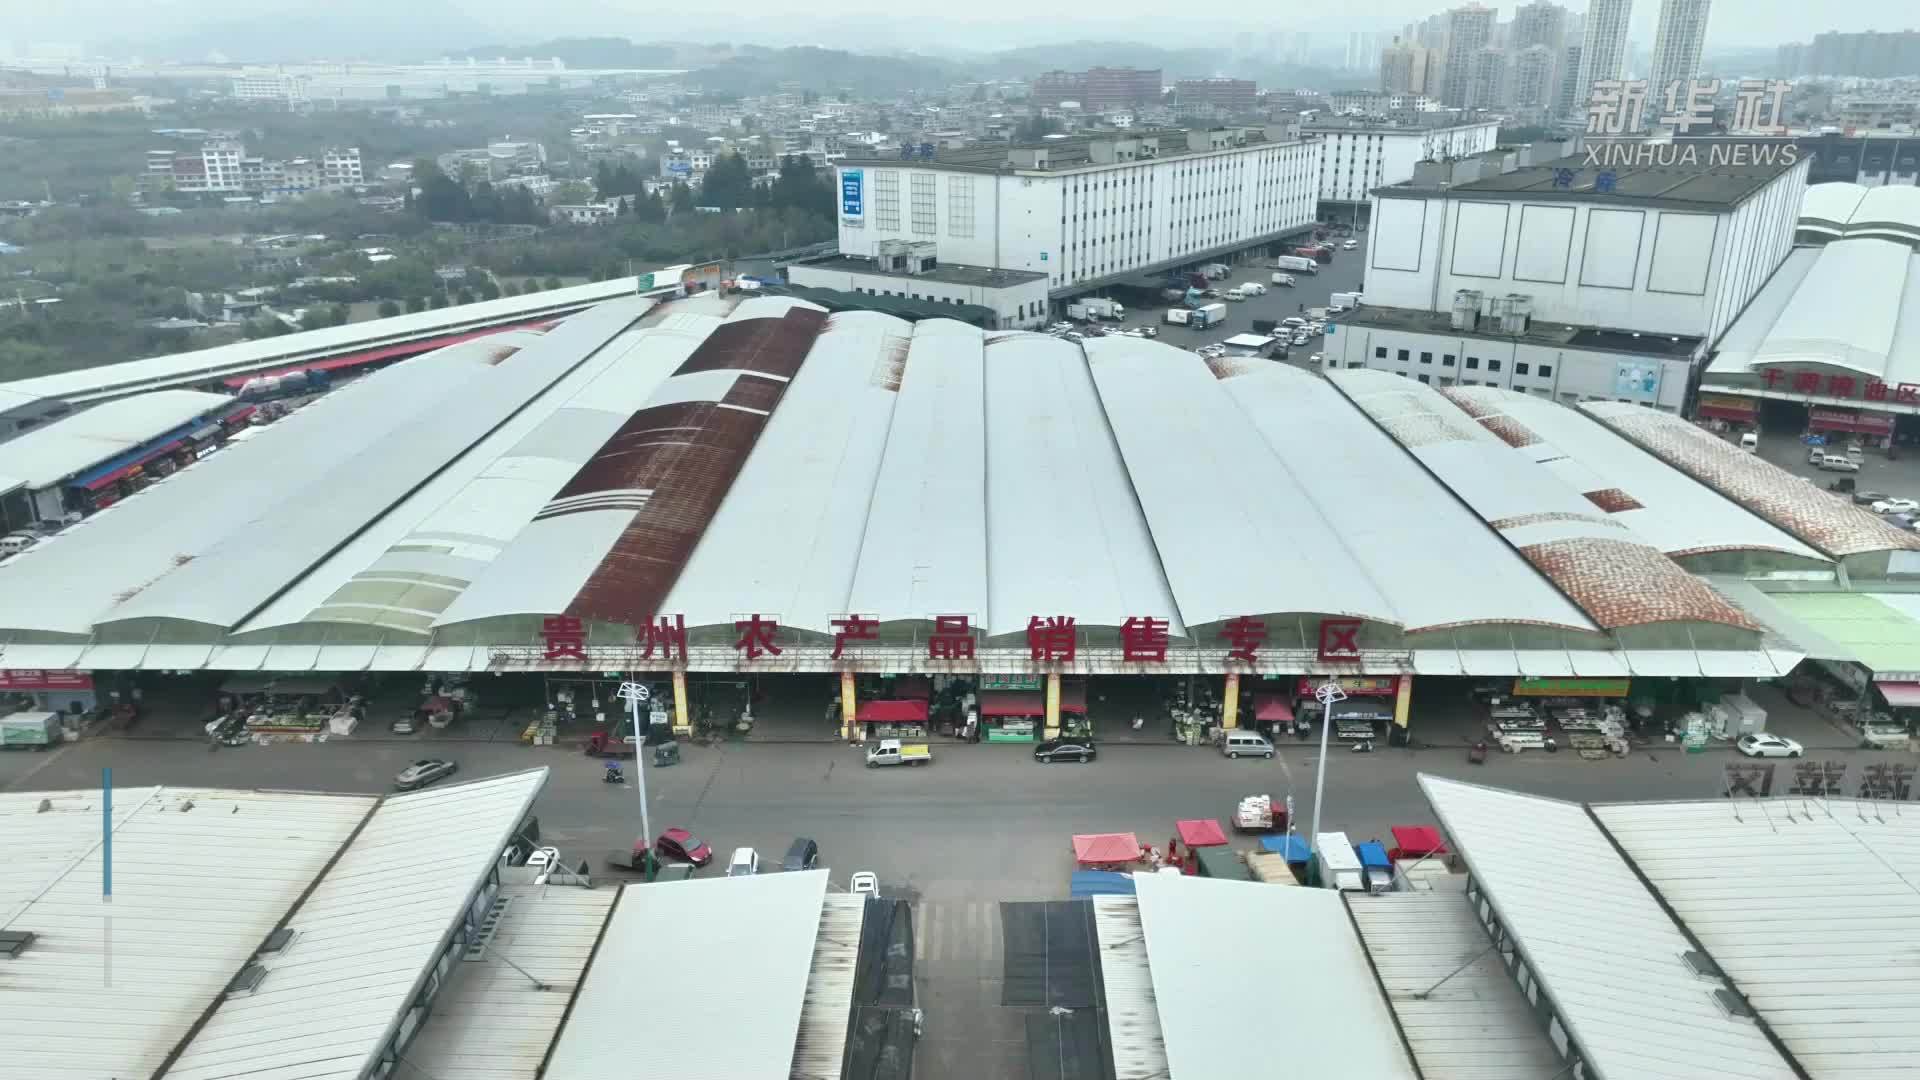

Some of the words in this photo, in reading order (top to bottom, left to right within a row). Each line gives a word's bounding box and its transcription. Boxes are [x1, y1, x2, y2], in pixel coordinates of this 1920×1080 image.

[540, 613, 1362, 663] 贵州农产品销售专区
